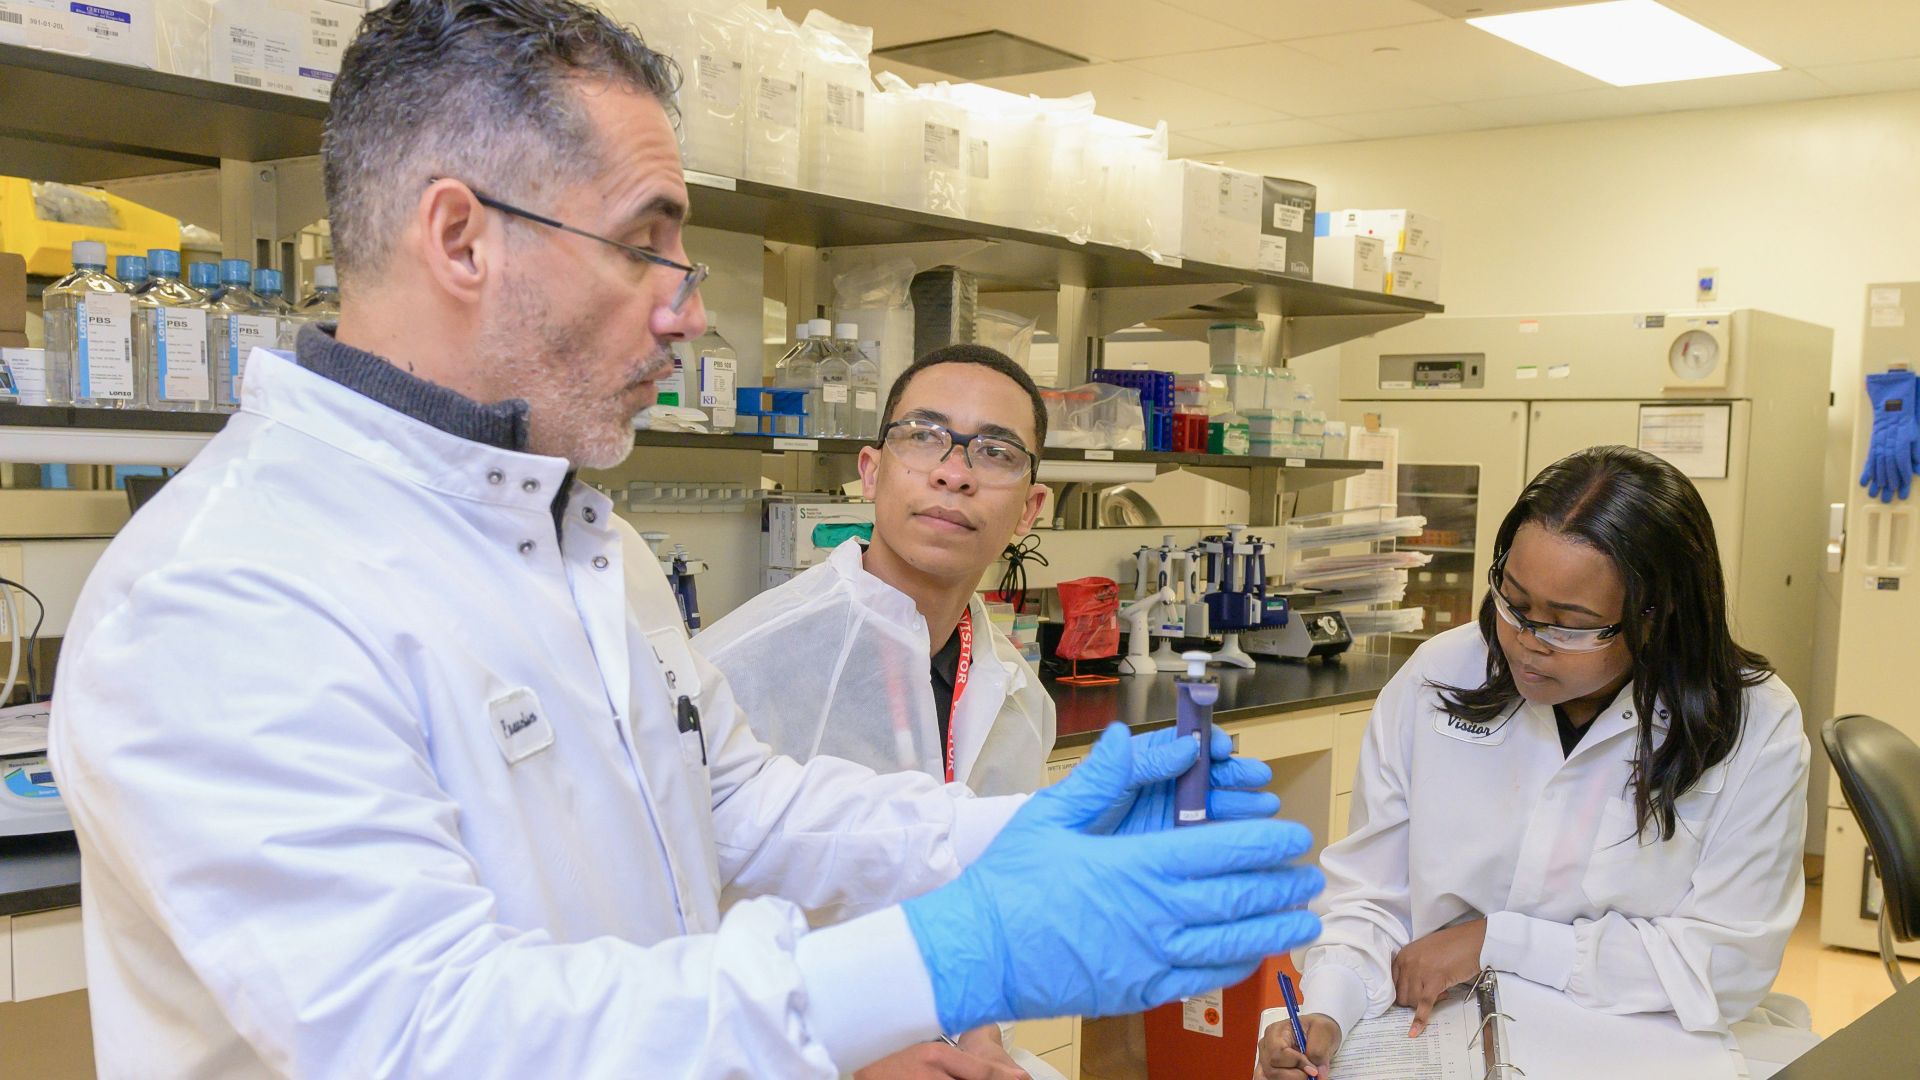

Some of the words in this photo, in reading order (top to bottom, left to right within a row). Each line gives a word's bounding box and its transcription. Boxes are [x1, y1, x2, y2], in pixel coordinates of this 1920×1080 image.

[89, 316, 112, 324] PBS
[166, 320, 188, 328] PBS
[239, 327, 260, 335] PBS
[800, 507, 806, 519] S
[957, 614, 972, 684] VISITOR
[1447, 714, 1491, 736] Visitor
